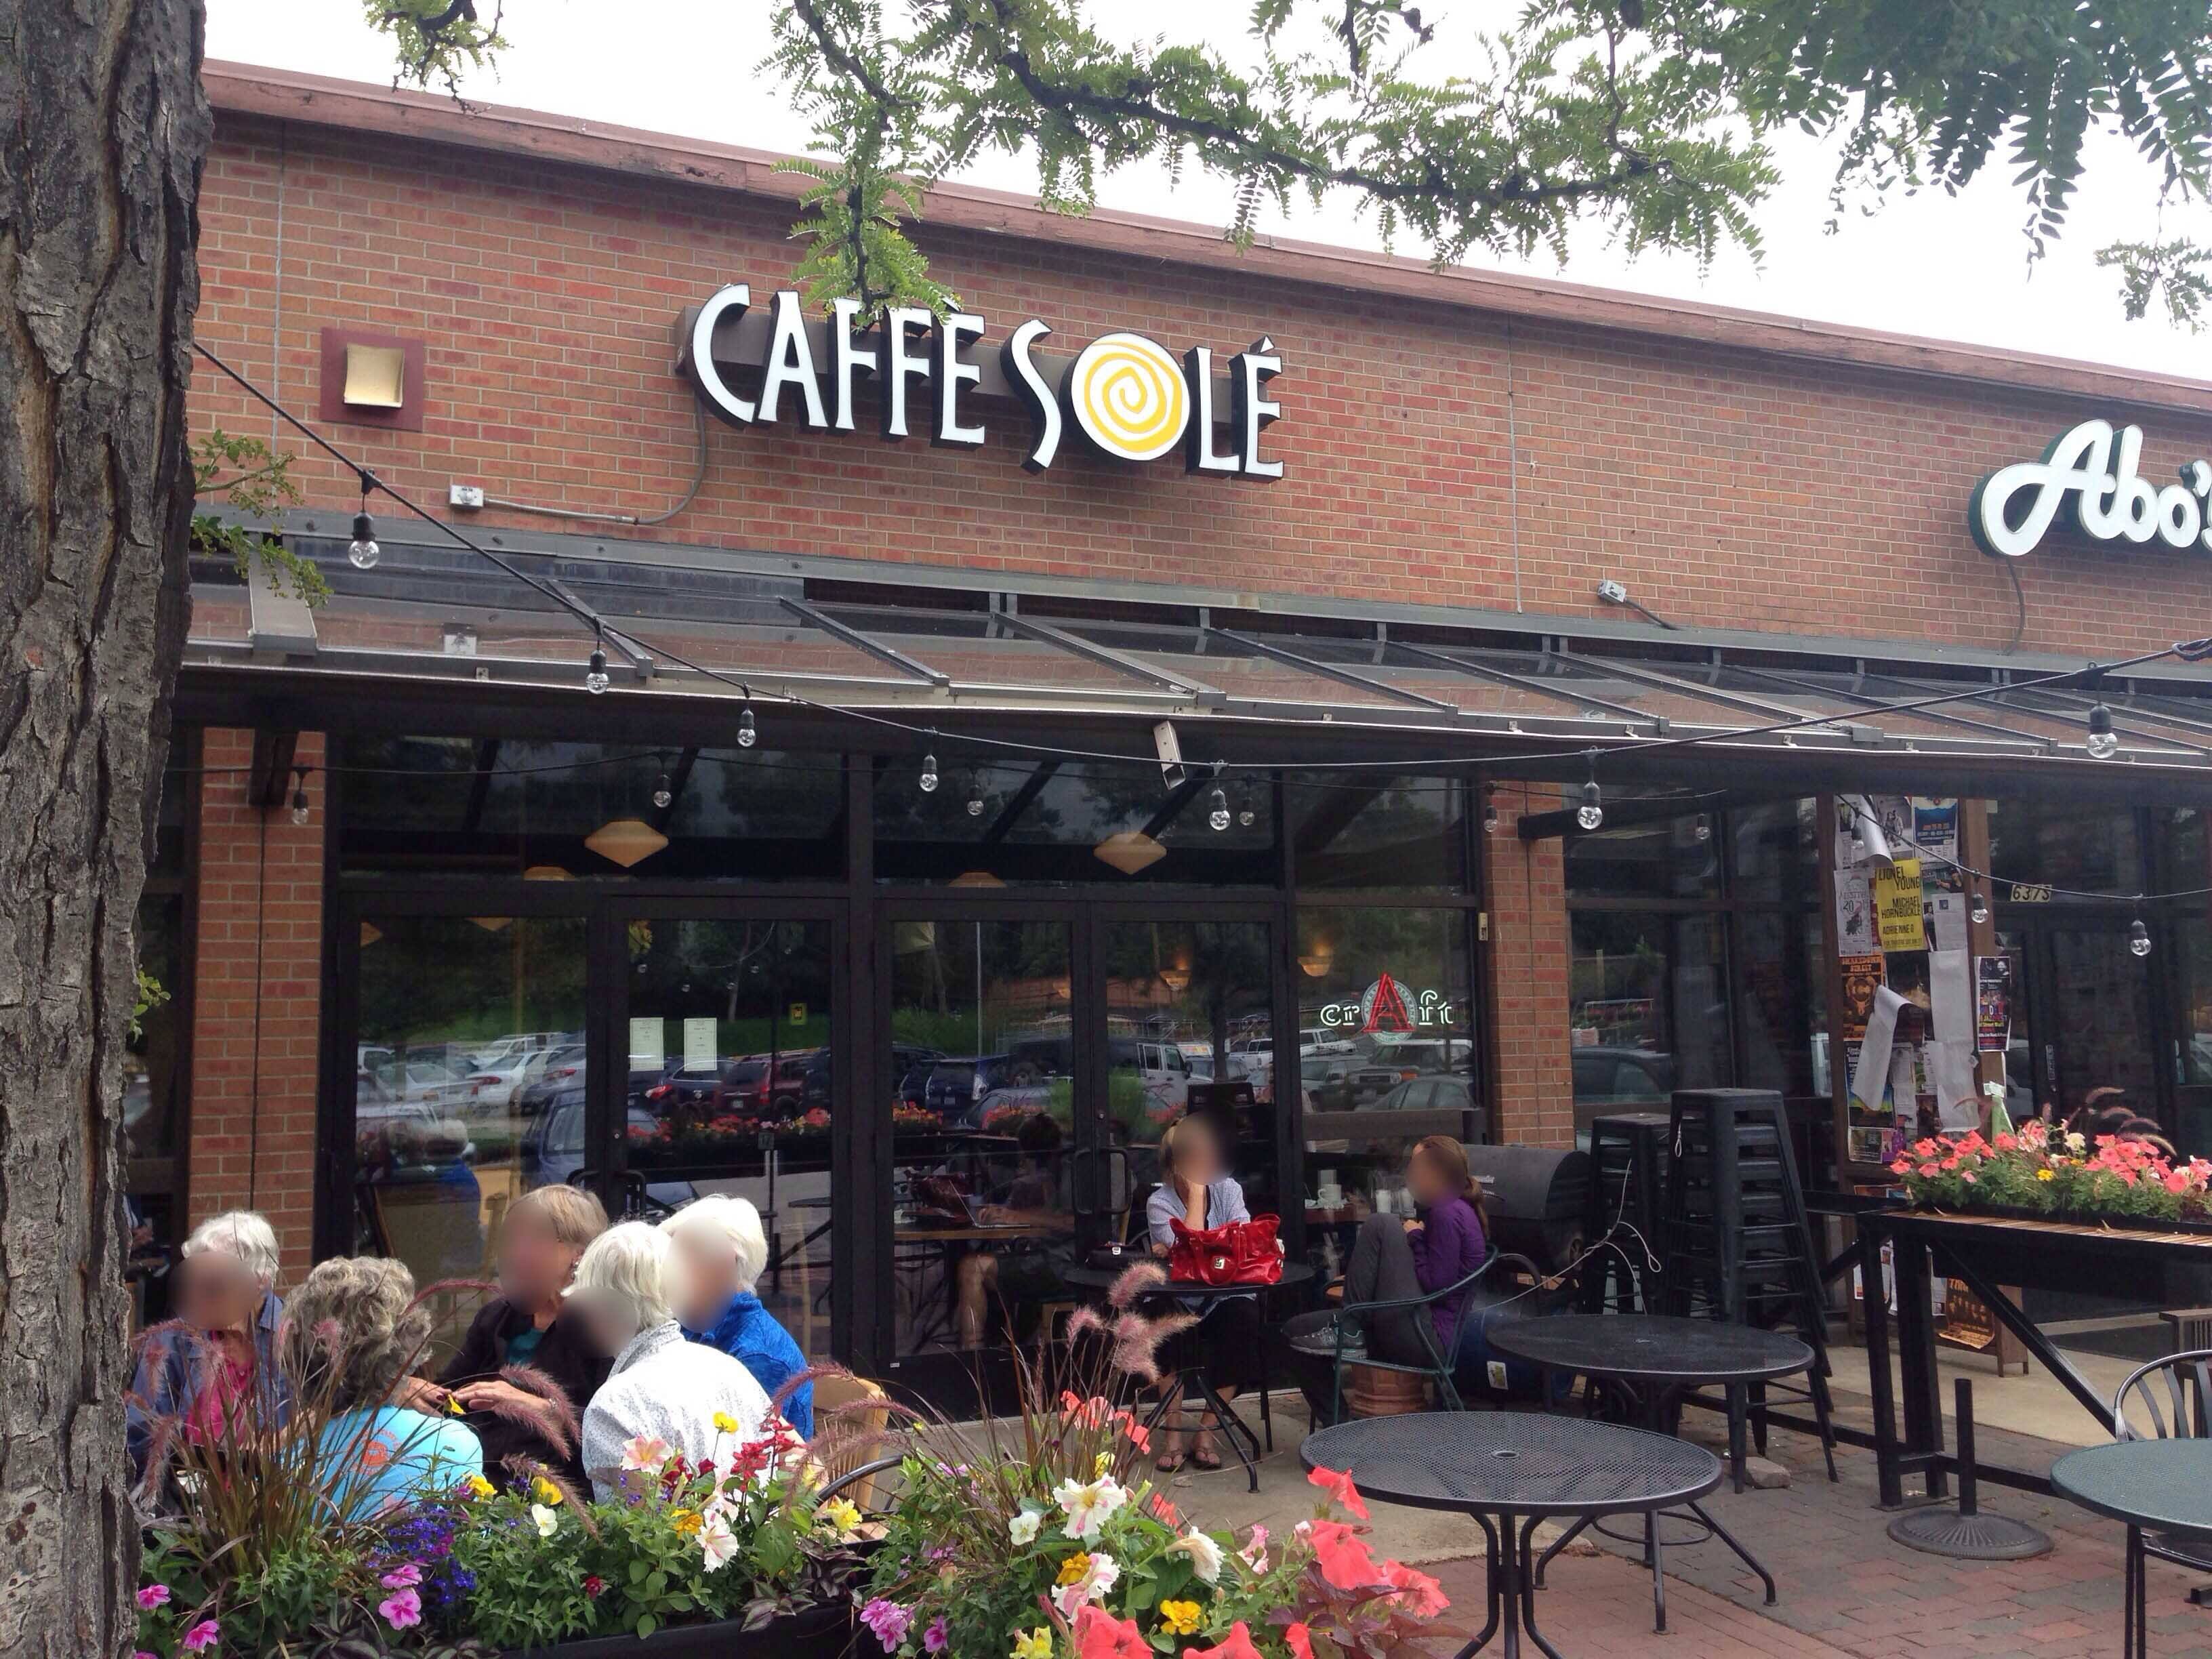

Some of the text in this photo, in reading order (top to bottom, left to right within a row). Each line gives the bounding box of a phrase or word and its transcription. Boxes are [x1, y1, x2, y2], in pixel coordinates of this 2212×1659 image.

[1004, 319, 1285, 478] SOLÉ
[1976, 418, 2212, 557] Abo'
[1878, 866, 1905, 881] LIONEL
[1895, 876, 1921, 891] YOUNG
[1892, 896, 1921, 909] MICHAEL
[1881, 907, 1921, 919] HORNBUCKLE
